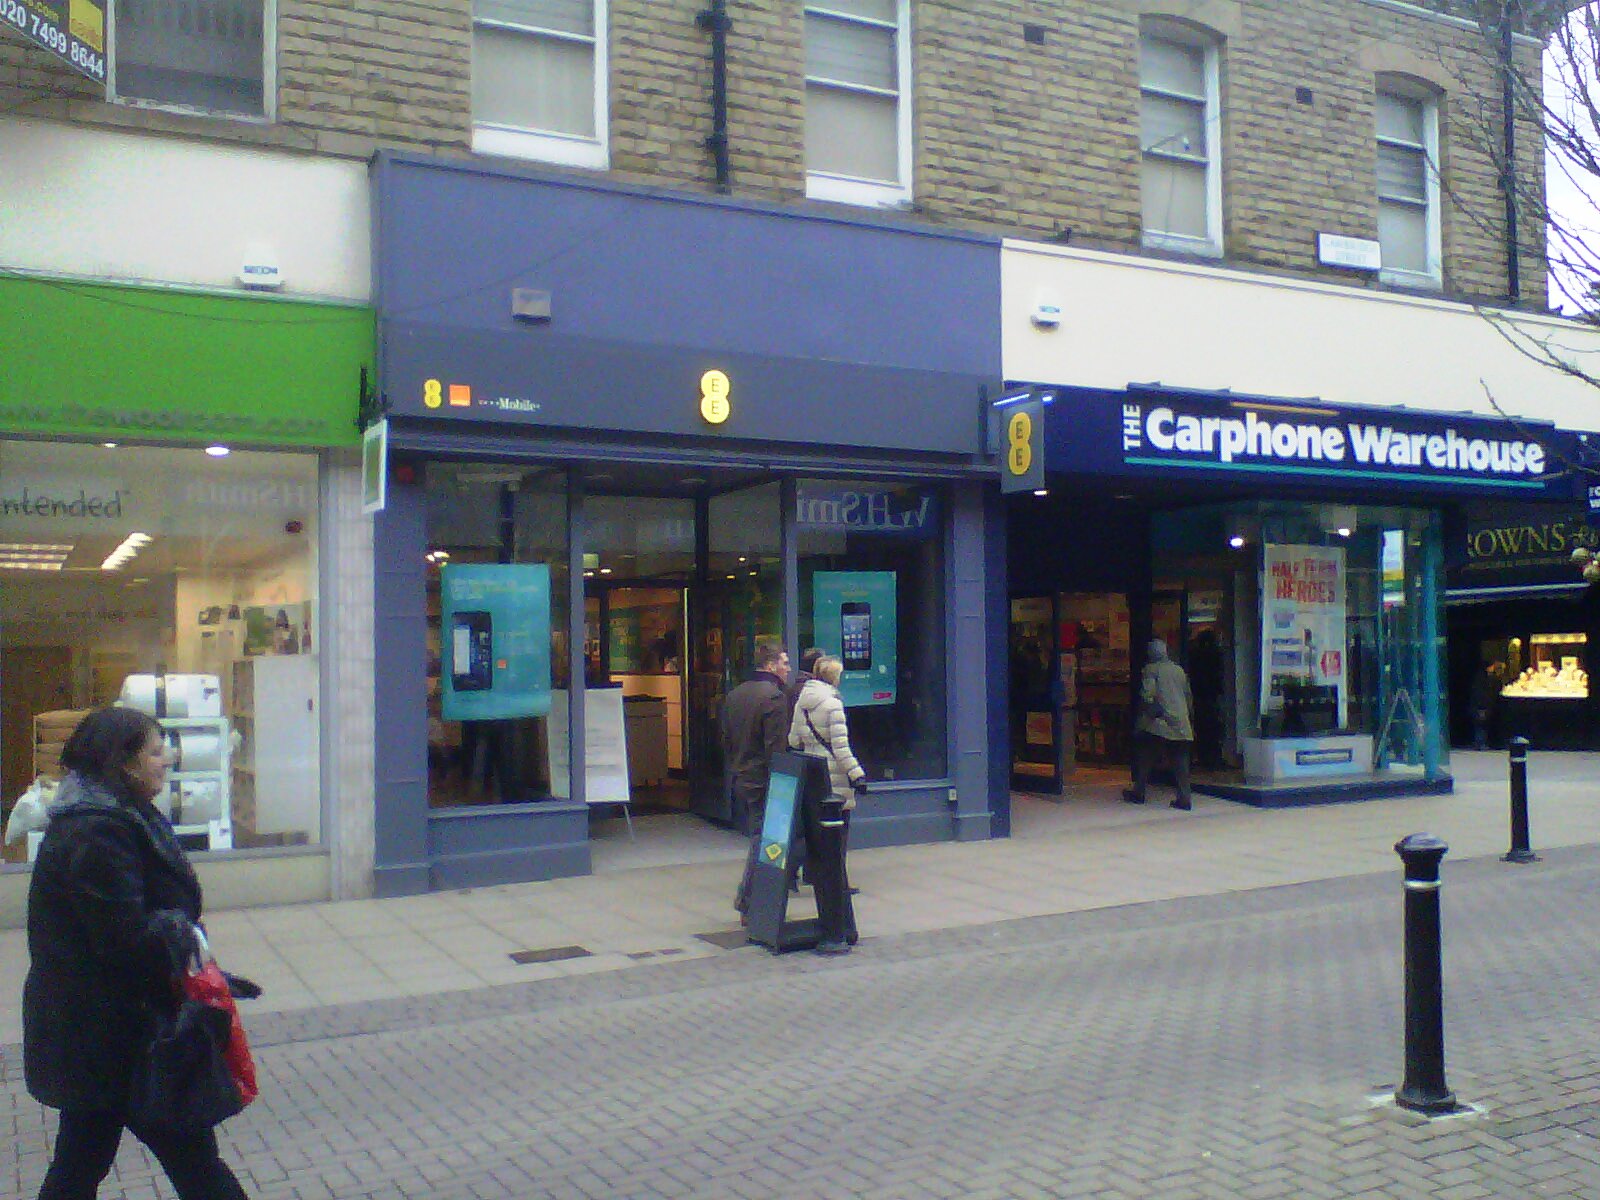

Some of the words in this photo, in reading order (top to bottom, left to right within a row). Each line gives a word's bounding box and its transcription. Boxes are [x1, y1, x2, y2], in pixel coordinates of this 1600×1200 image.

[31, 14, 67, 54] 7499
[71, 41, 104, 79] 8644
[1123, 404, 1141, 450] THE
[1146, 407, 1345, 462] Carphone
[1348, 423, 1545, 473] Warehouse
